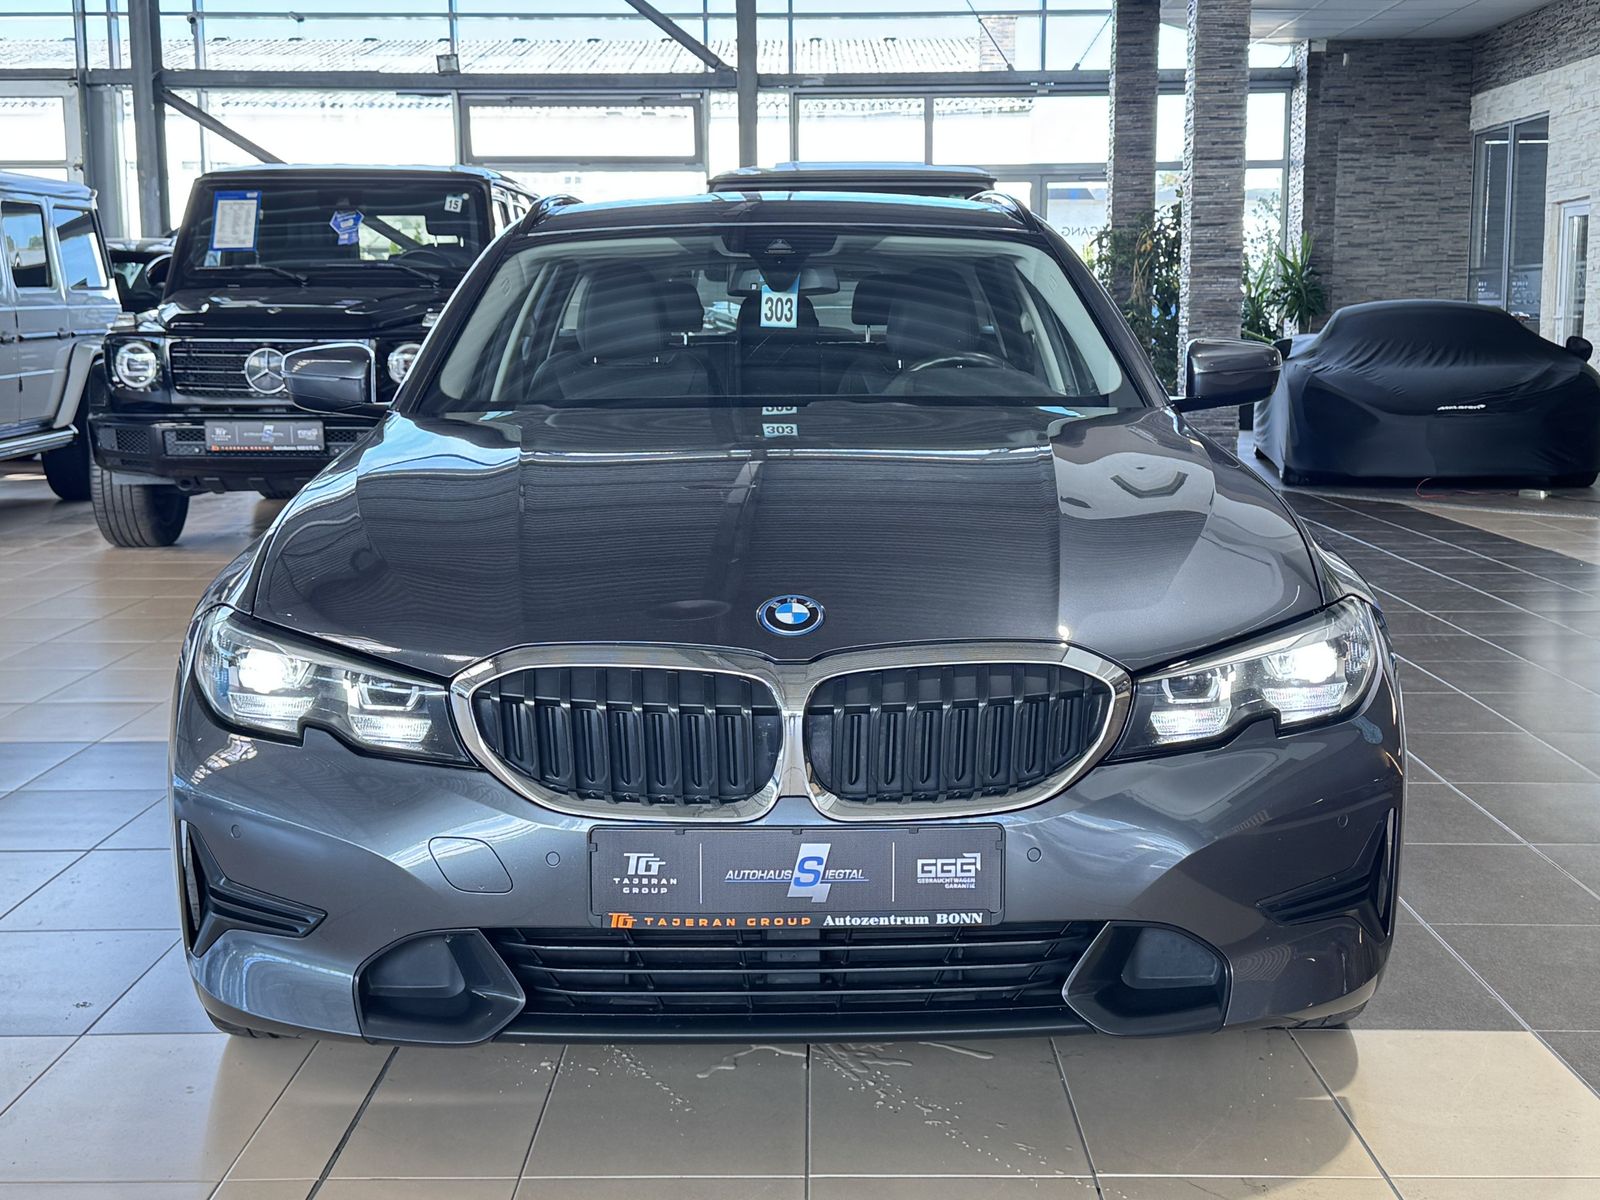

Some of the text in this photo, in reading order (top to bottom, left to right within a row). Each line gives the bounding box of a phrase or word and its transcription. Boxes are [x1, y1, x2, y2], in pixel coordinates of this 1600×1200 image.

[448, 199, 460, 210] 15
[764, 296, 794, 323] 303
[623, 852, 666, 875] TG
[917, 858, 976, 878] GGG
[612, 877, 677, 885] TAJERAN
[725, 869, 792, 880] AUTOHAUS
[608, 912, 983, 929] TG TAJERAN GROUP Autozentrum BONN
